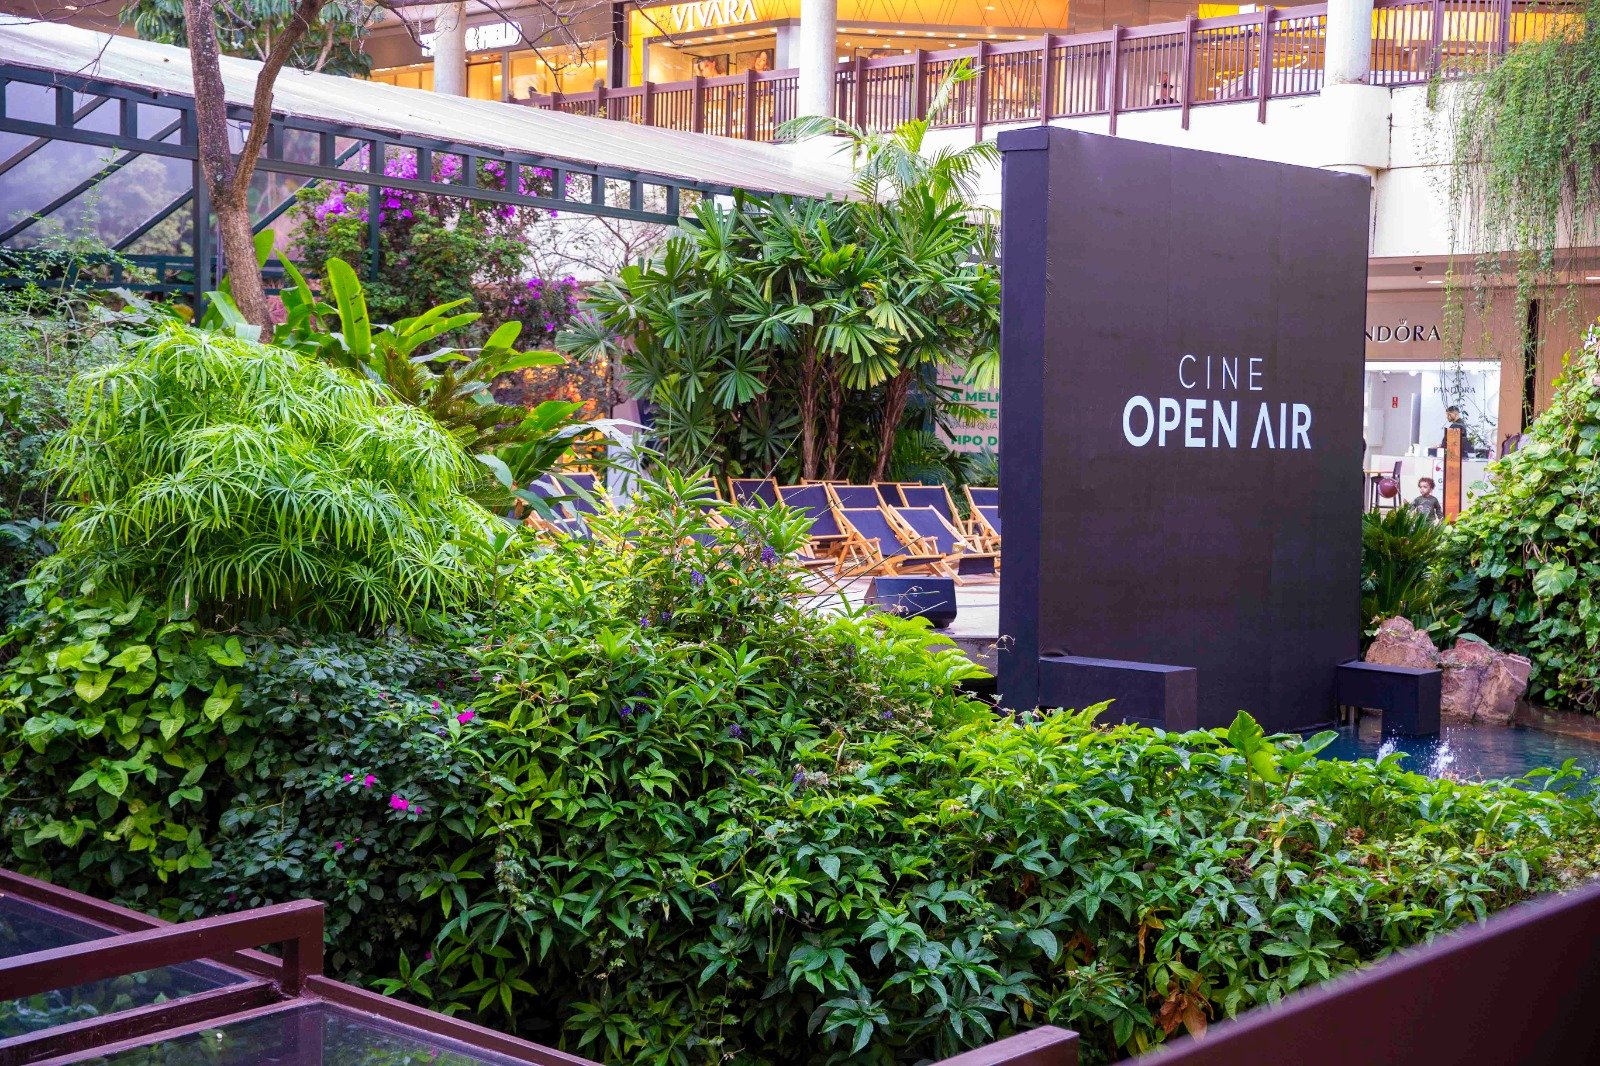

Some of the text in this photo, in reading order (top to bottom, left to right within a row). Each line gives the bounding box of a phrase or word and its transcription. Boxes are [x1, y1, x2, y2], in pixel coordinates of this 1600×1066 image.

[671, 0, 758, 32] VIVARA
[1179, 354, 1263, 391] CINE
[1122, 395, 1312, 449] OPEN AIR
